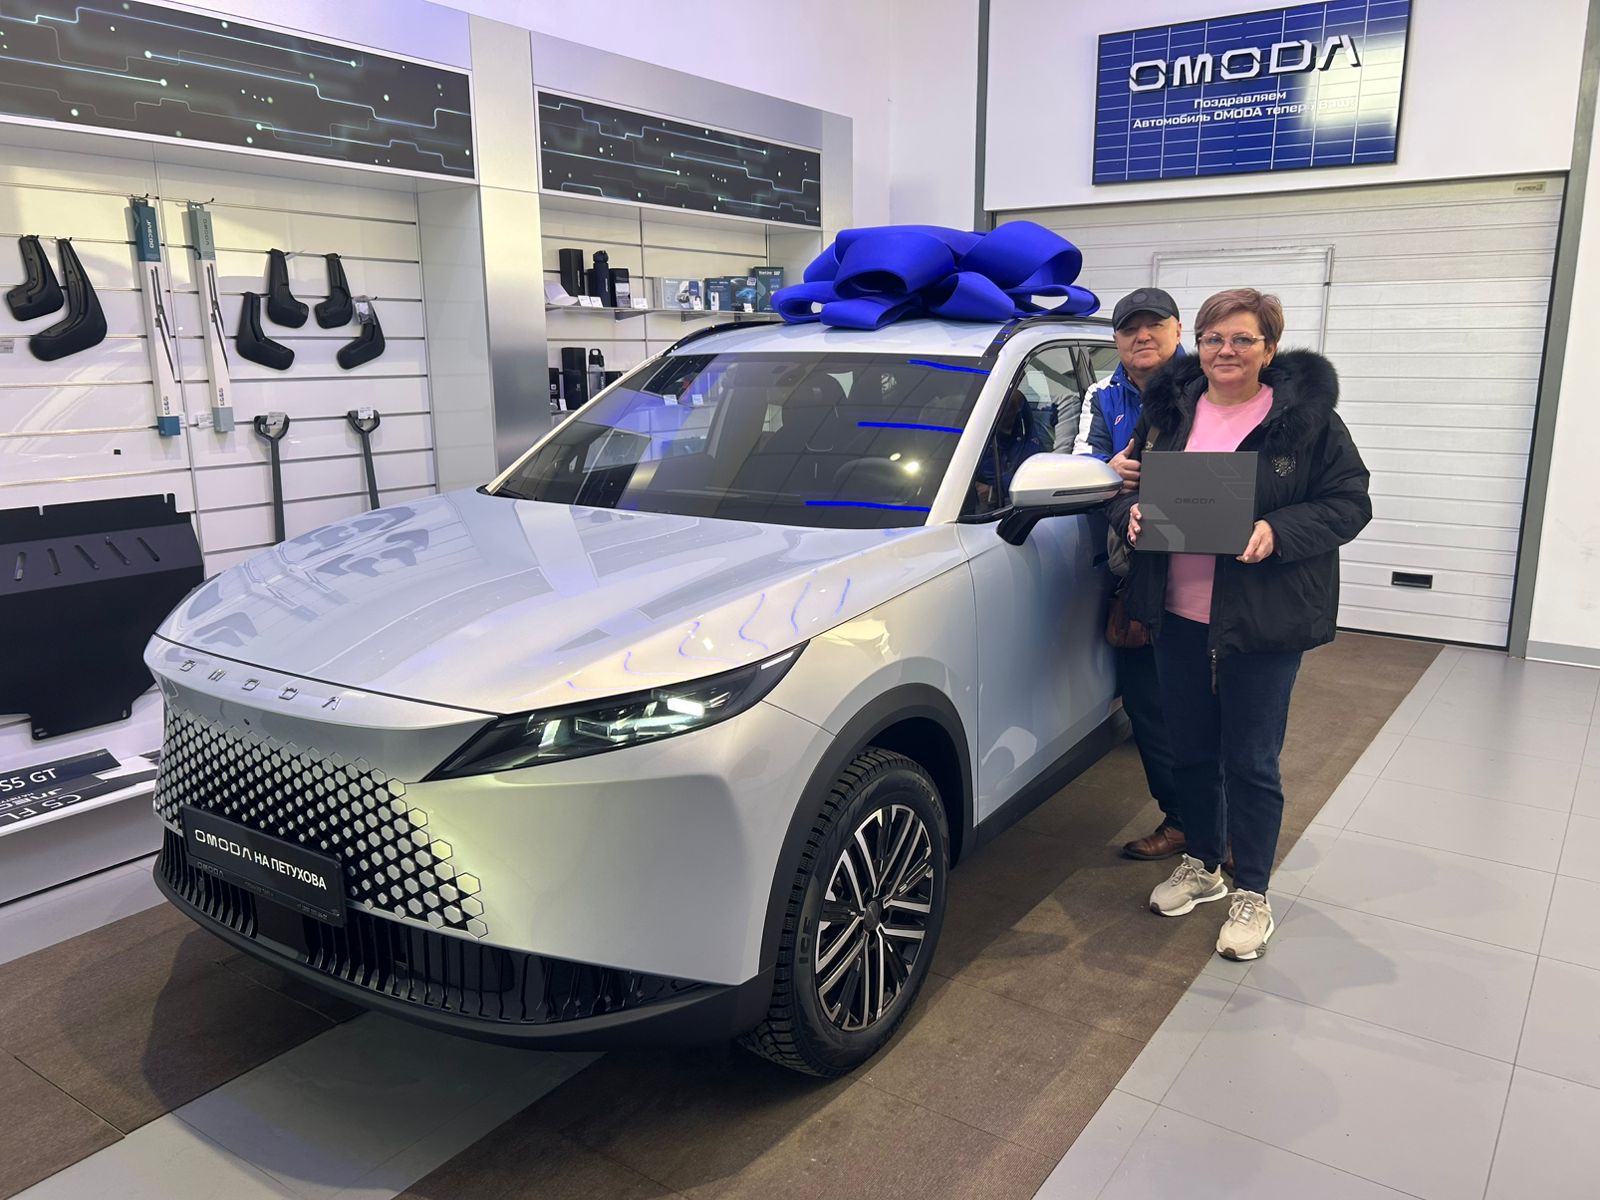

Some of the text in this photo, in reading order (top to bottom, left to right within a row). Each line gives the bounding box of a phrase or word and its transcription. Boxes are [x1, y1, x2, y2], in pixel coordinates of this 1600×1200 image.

[1129, 34, 1362, 92] OMODA
[1194, 91, 1287, 109] Поздравляем
[1132, 113, 1211, 129] Автомобиль
[1213, 106, 1262, 120] OMODA
[29, 767, 56, 783] GT
[194, 829, 253, 862] OMODA
[254, 850, 270, 869] НА
[271, 857, 328, 891] ПЕТУХОВА
